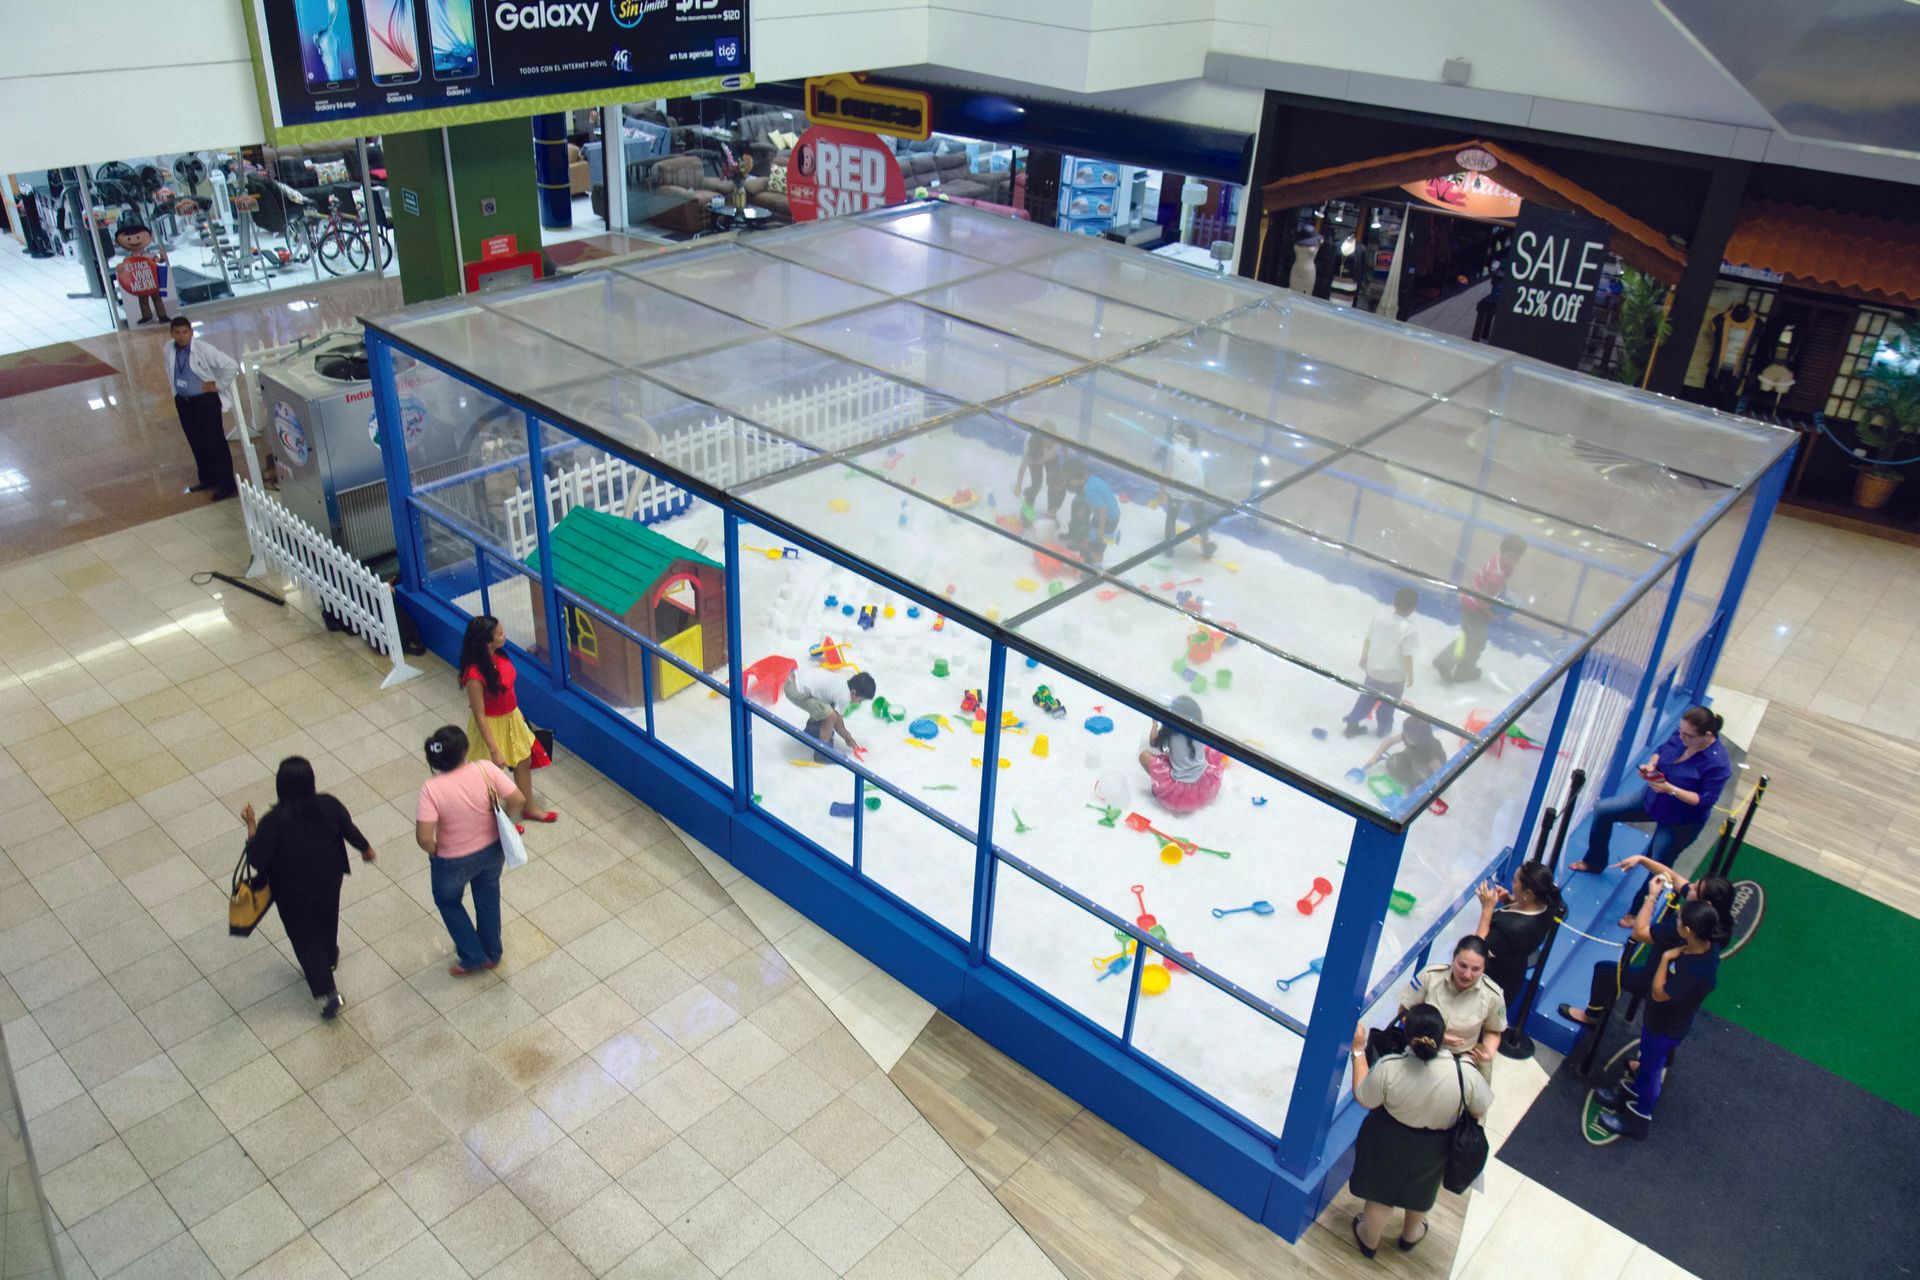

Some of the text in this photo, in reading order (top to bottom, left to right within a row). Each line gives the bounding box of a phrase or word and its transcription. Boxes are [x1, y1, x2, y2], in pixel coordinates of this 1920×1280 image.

[495, 0, 599, 32] Galaxy
[619, 0, 639, 18] Sin
[723, 9, 740, 21] $120
[689, 50, 713, 60] agencias
[520, 65, 539, 75] TODOS
[540, 64, 553, 73] CON
[562, 61, 589, 70] INTERNET
[816, 139, 887, 195] RED
[816, 186, 886, 219] SAL
[1511, 230, 1604, 292] SALE
[132, 269, 154, 281] VIVIR
[130, 279, 157, 293] MEJOR
[1512, 286, 1584, 323] 25% Off
